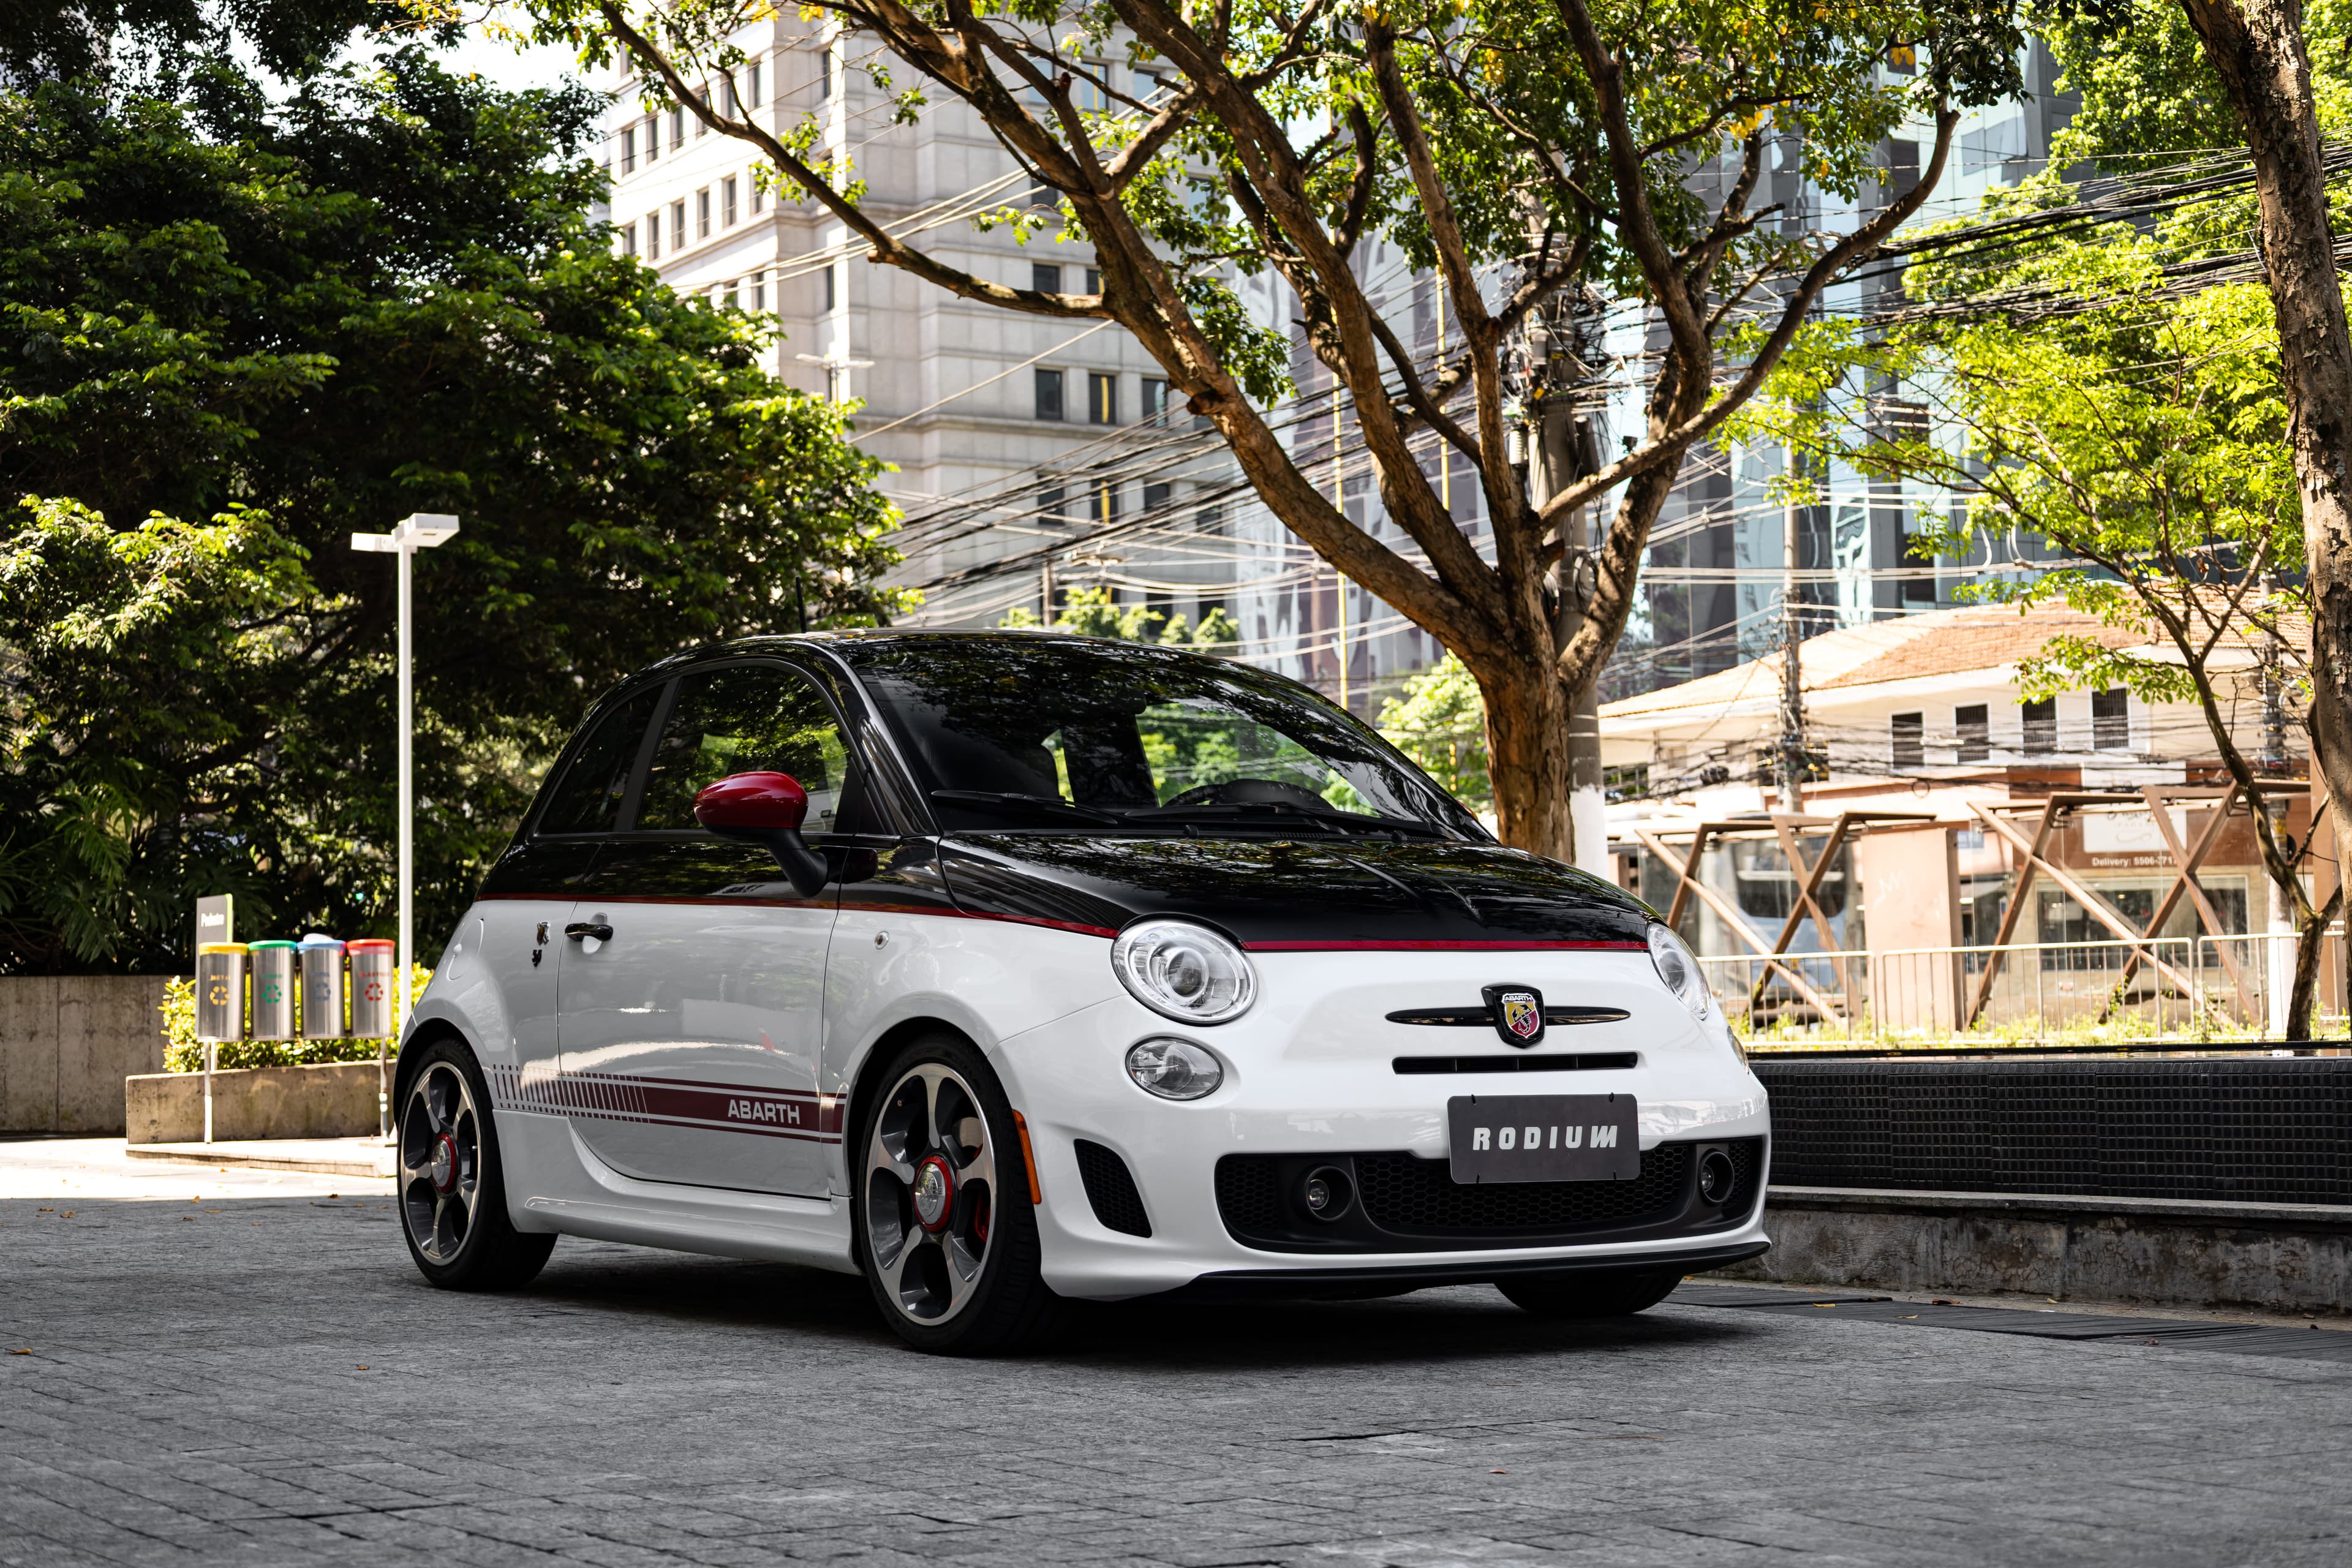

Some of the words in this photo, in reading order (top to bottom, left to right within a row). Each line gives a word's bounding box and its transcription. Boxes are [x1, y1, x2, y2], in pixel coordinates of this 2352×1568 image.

[2092, 856, 2132, 867] Delivery:
[2134, 856, 2176, 865] 5506-71
[728, 1099, 800, 1125] ABARTH
[1472, 1125, 1618, 1150] RODIUM
